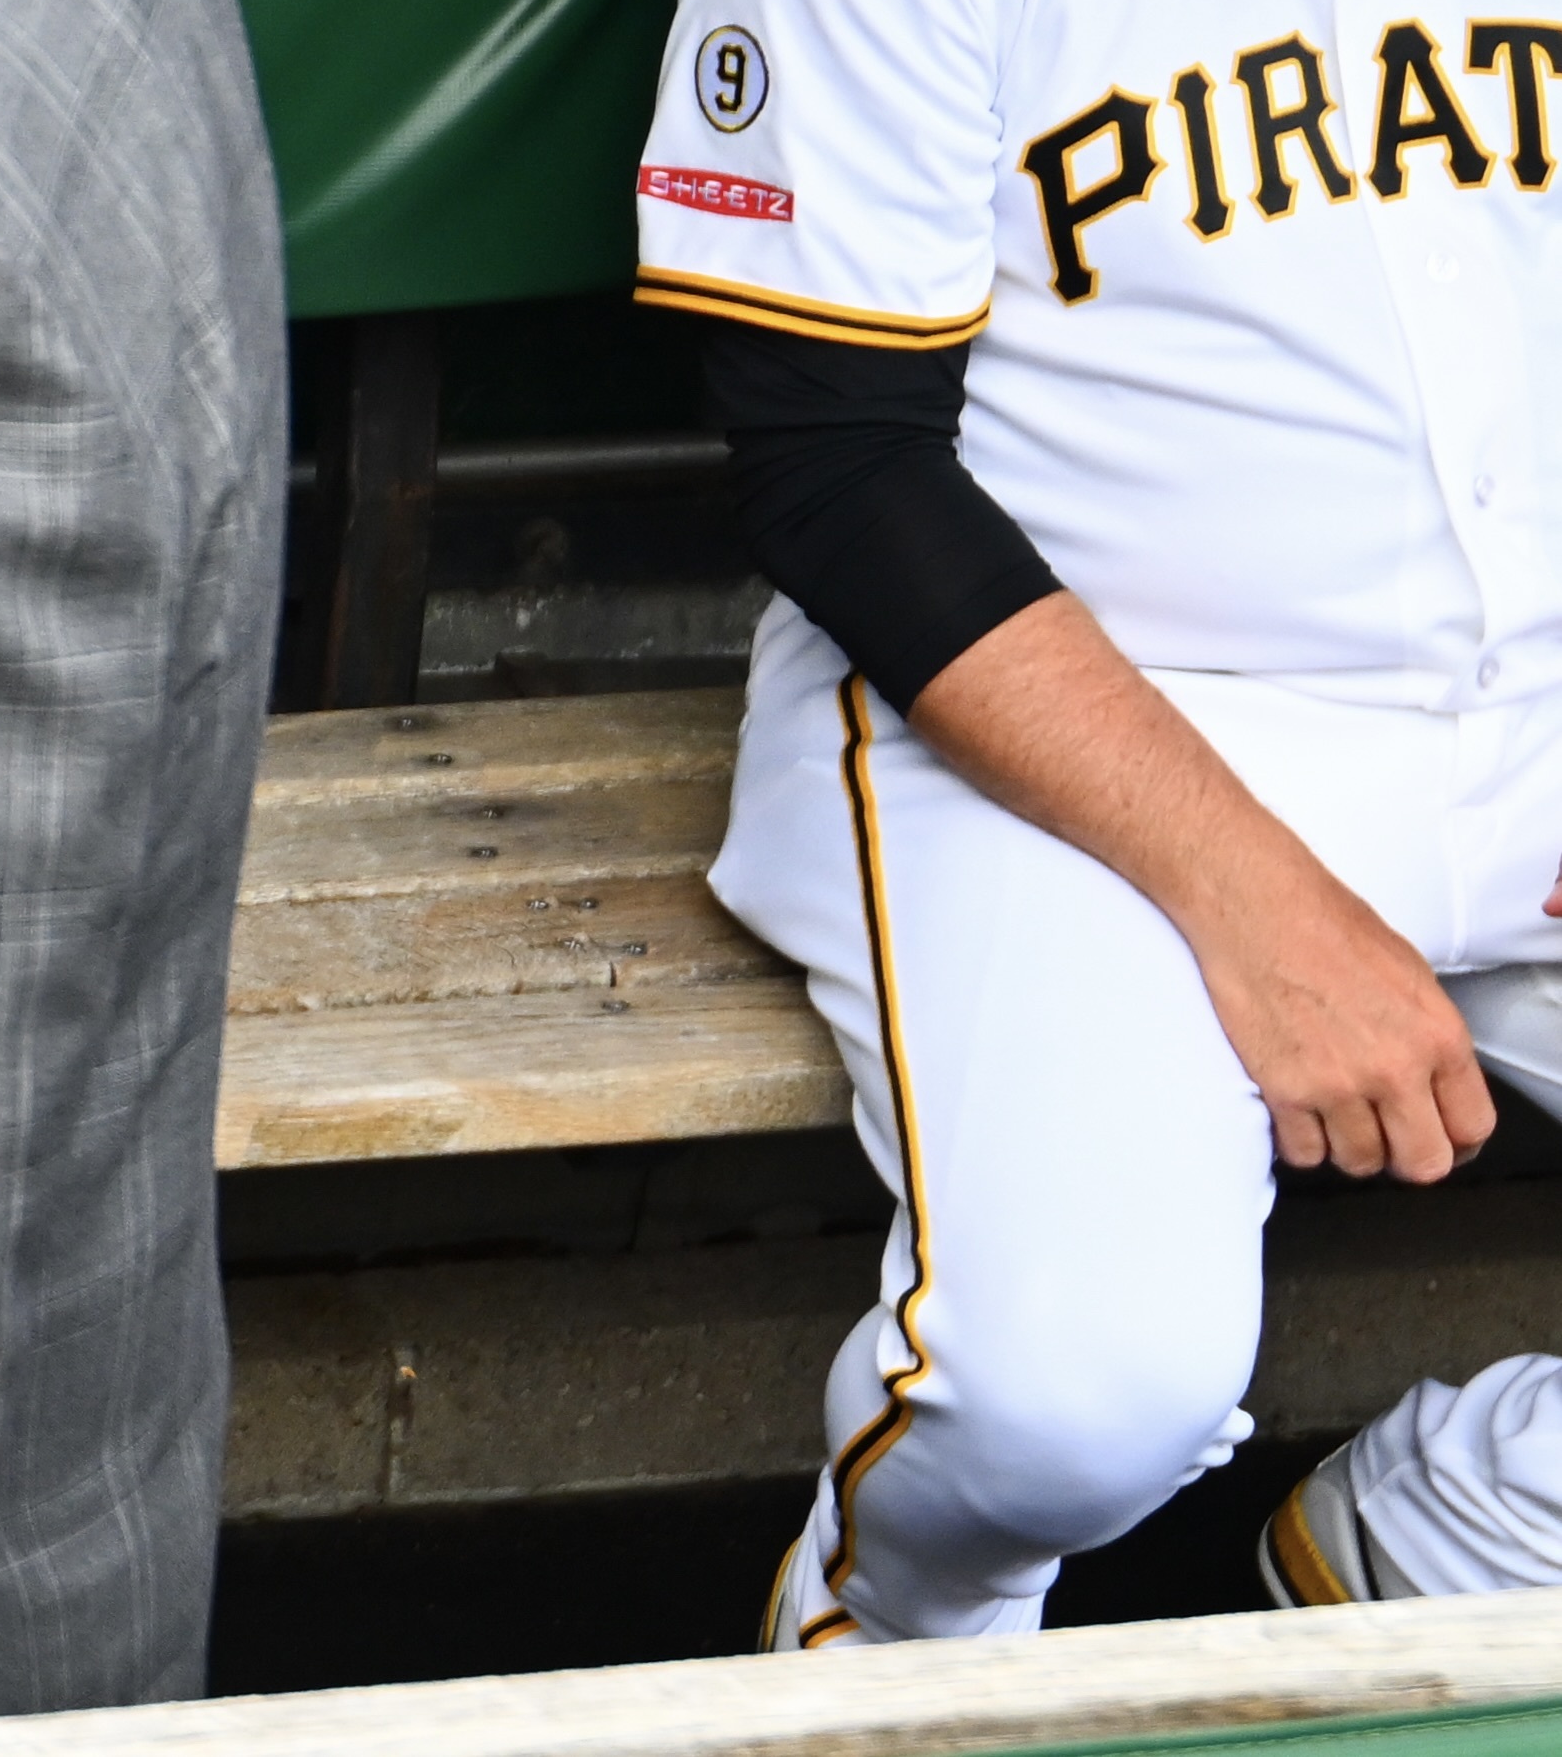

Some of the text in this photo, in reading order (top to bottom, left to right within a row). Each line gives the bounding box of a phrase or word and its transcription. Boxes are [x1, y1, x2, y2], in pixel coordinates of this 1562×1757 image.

[716, 43, 748, 115] 9
[648, 170, 791, 219] SHEETZ
[1017, 17, 1562, 307] PIRAT
